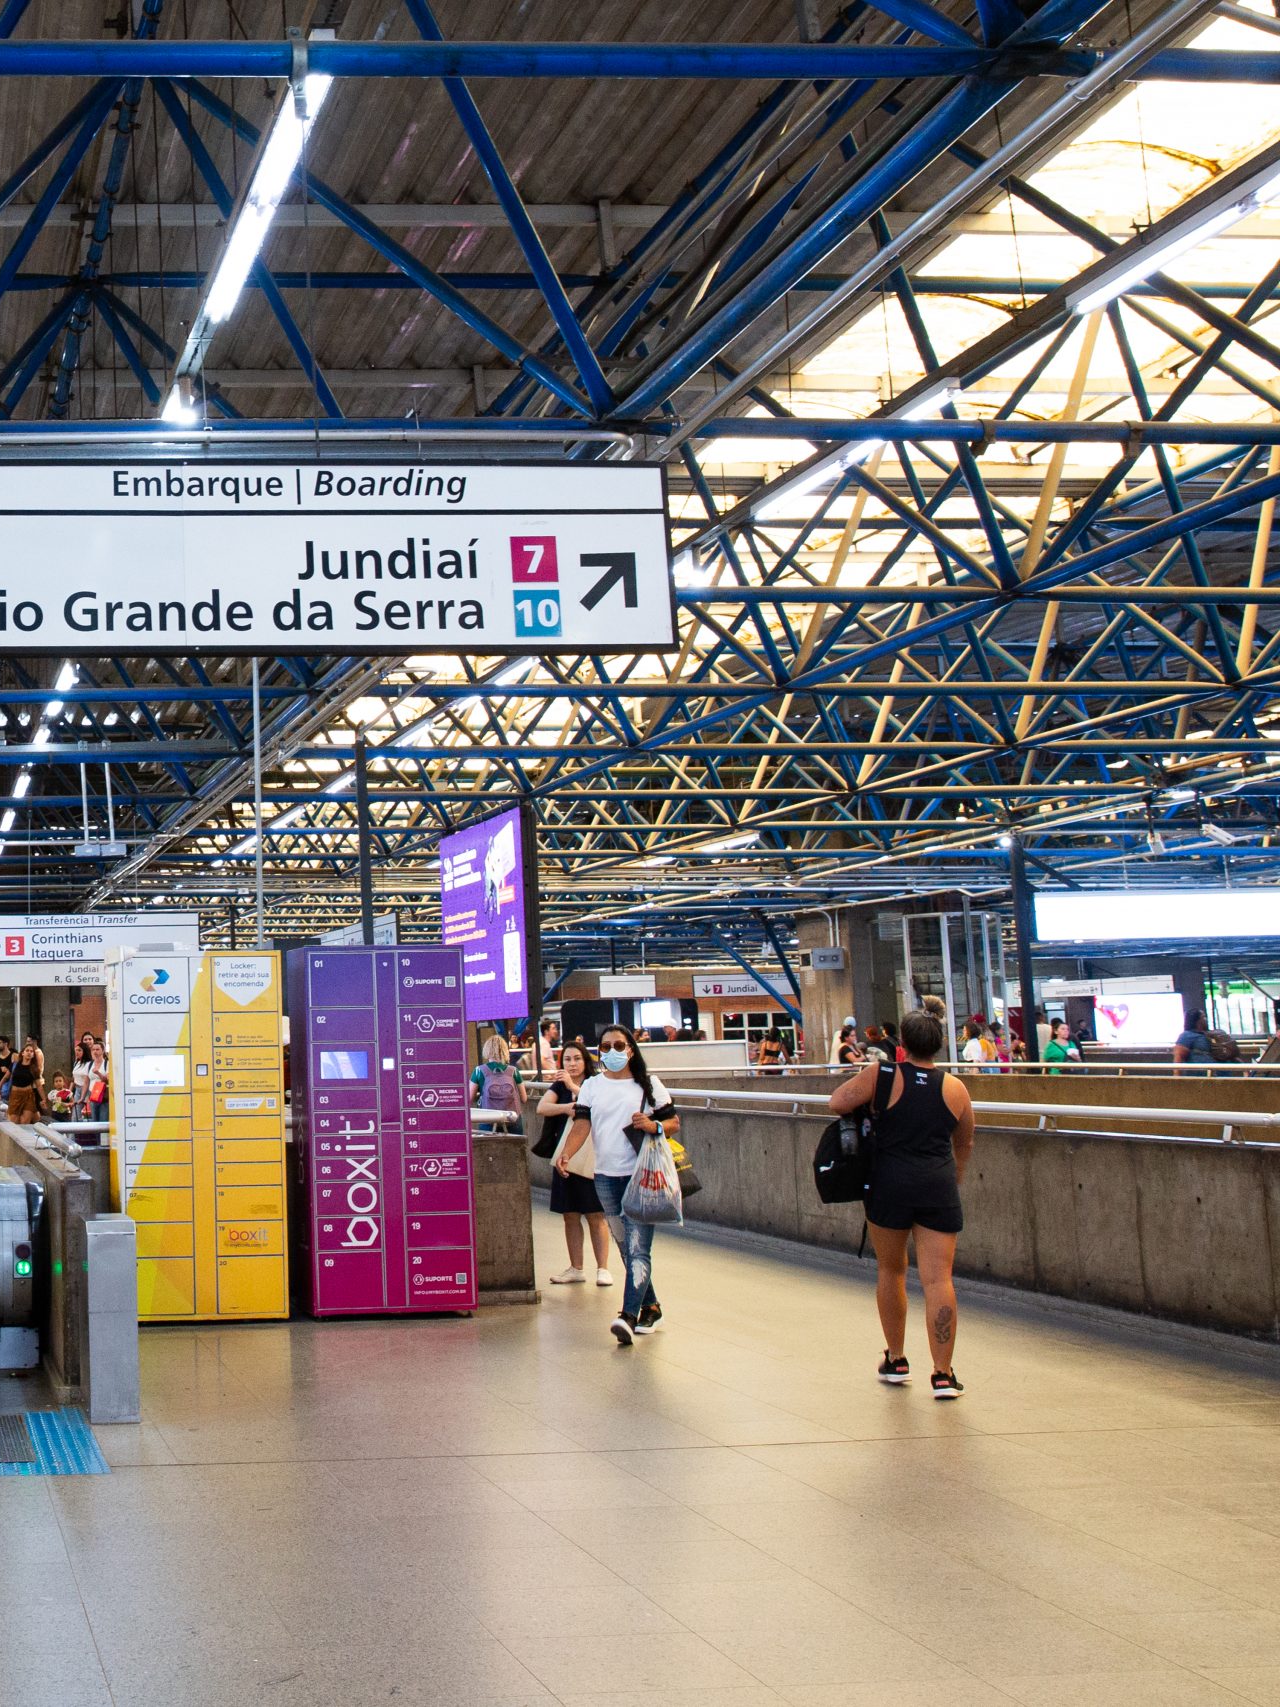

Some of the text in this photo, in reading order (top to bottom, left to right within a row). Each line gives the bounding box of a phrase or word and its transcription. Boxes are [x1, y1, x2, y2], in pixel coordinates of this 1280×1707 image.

[112, 469, 467, 504] Embarque Boarding
[297, 537, 478, 581] Jundiaí
[523, 545, 545, 574] 7
[63, 588, 253, 632] Grande
[272, 588, 335, 631] da
[355, 593, 485, 631] Serra
[516, 599, 560, 628] 10
[25, 915, 138, 925] Transferência Transfer
[31, 933, 103, 945] Corinthians
[10, 940, 20, 953] 3
[31, 948, 84, 961] Itaquera
[314, 960, 323, 968] 01
[77, 975, 100, 983] Serra
[129, 994, 181, 1005] Correios
[316, 1016, 326, 1024] 02
[405, 1048, 414, 1056] 12
[405, 1071, 415, 1079] 13
[320, 1096, 329, 1104] 03
[320, 1119, 330, 1127] 04
[321, 1143, 331, 1151] 05
[322, 1166, 331, 1174] 06
[409, 1164, 419, 1172] 17
[334, 1120, 379, 1247] boxit
[322, 1190, 332, 1198] 07
[410, 1187, 419, 1195] 18
[323, 1224, 333, 1232] 08
[411, 1222, 421, 1230] 19
[229, 1228, 268, 1241] boxit
[325, 1259, 334, 1267] 09
[412, 1256, 422, 1264] 20
